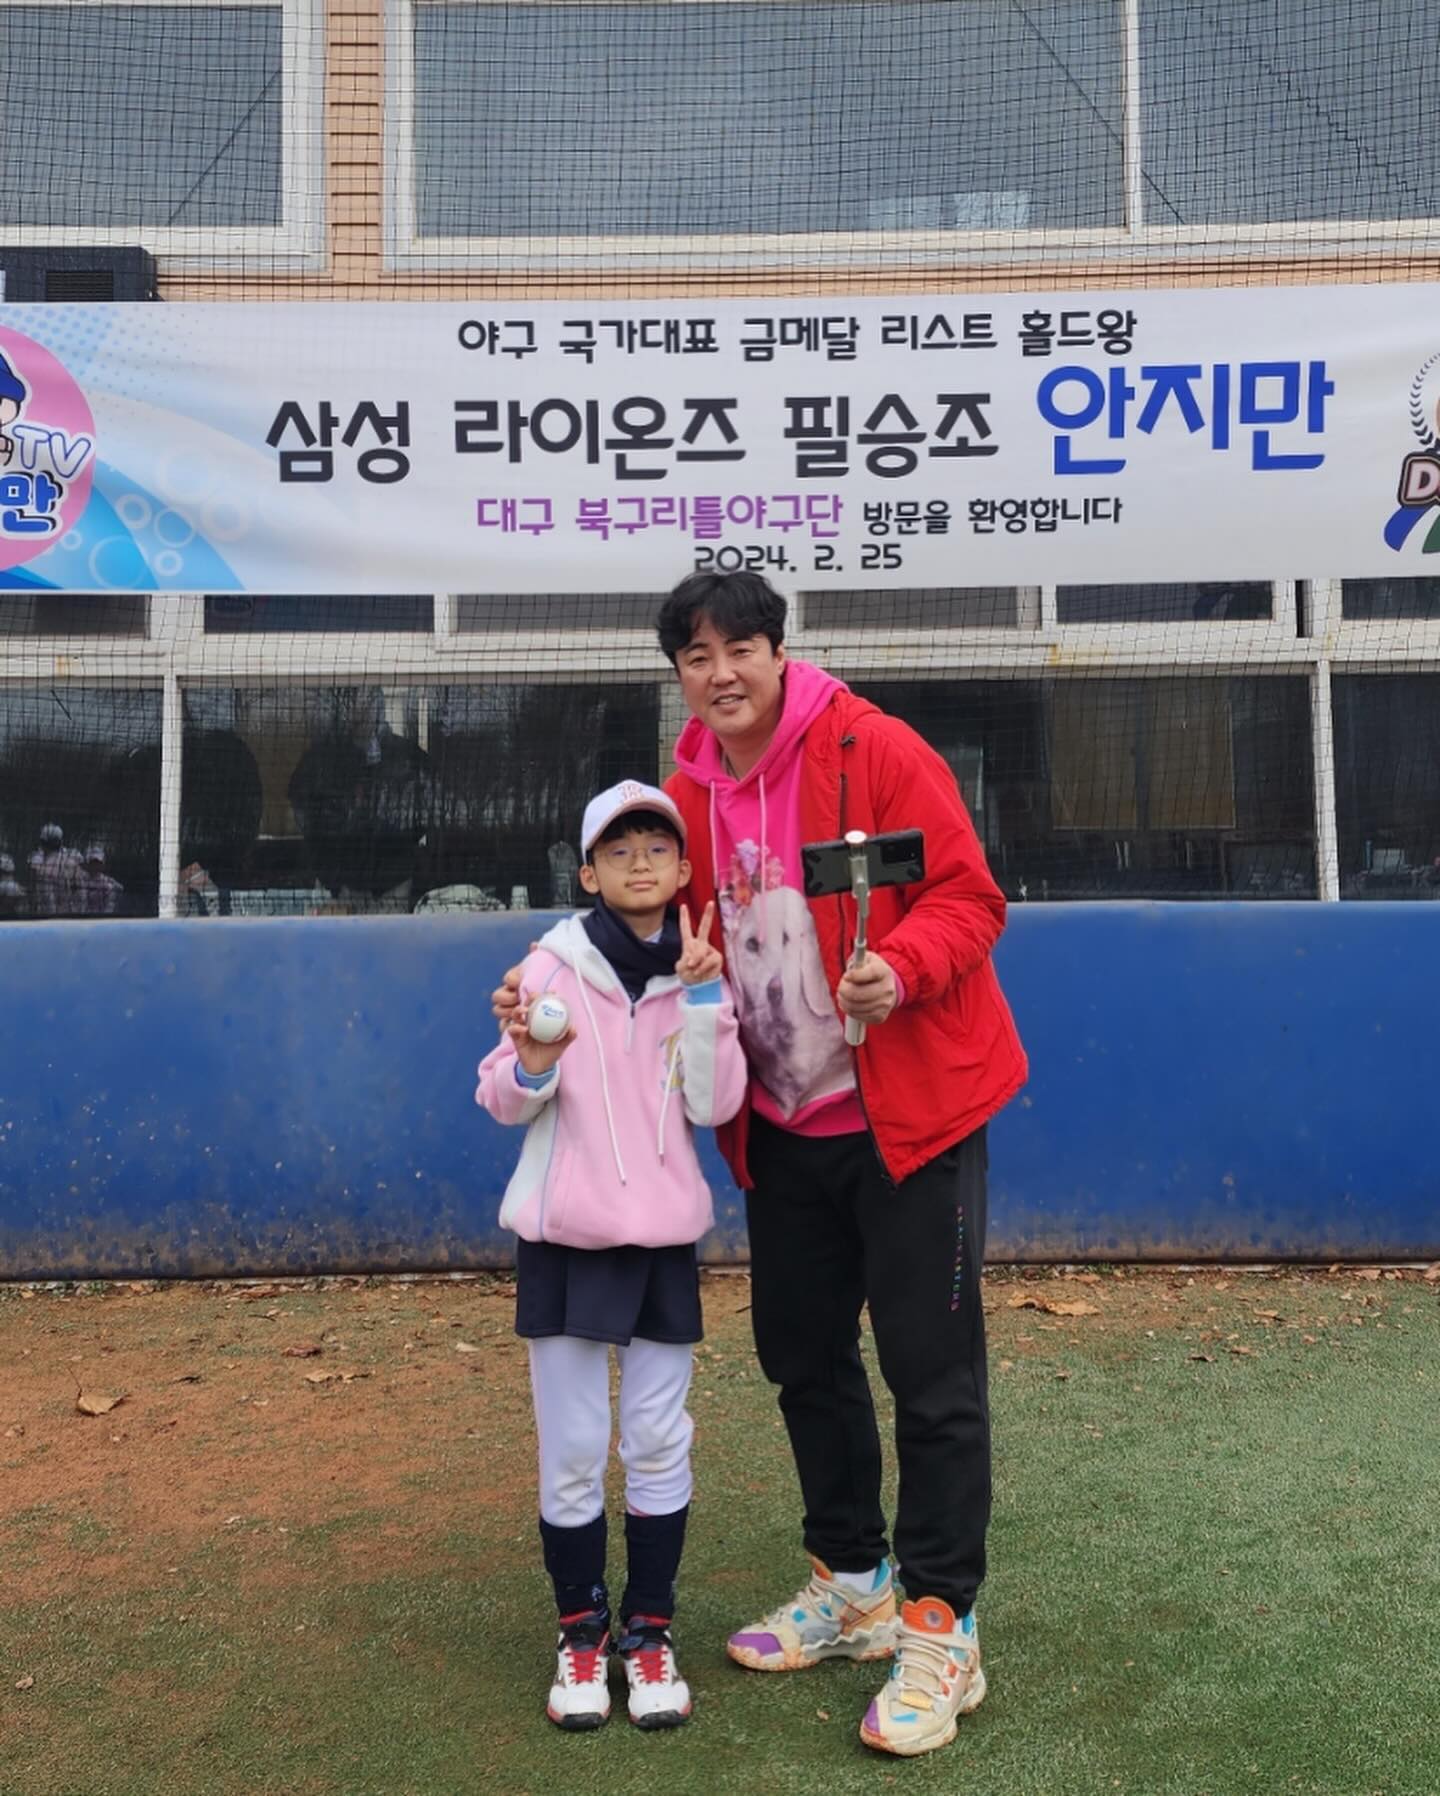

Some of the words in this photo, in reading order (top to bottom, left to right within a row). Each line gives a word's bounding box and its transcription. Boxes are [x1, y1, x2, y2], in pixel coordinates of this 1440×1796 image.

[457, 319, 539, 360] 야구
[558, 318, 720, 365] 국가대표
[739, 316, 861, 363] 금메달
[881, 313, 999, 351] 리스트
[1017, 309, 1138, 356] 홀드왕
[264, 400, 411, 484] 삼성
[453, 395, 747, 480] 라이온즈
[783, 392, 1000, 479] 필승조
[1036, 360, 1335, 476] 안지만
[12, 423, 92, 479] TV
[477, 498, 555, 536] 대구
[575, 494, 844, 541] 북구리틀야구단
[863, 499, 953, 537] 방문을
[967, 496, 1123, 535] 환영합니다
[694, 545, 798, 573] 2024.
[813, 544, 844, 572] 2.
[860, 543, 903, 570] 25
